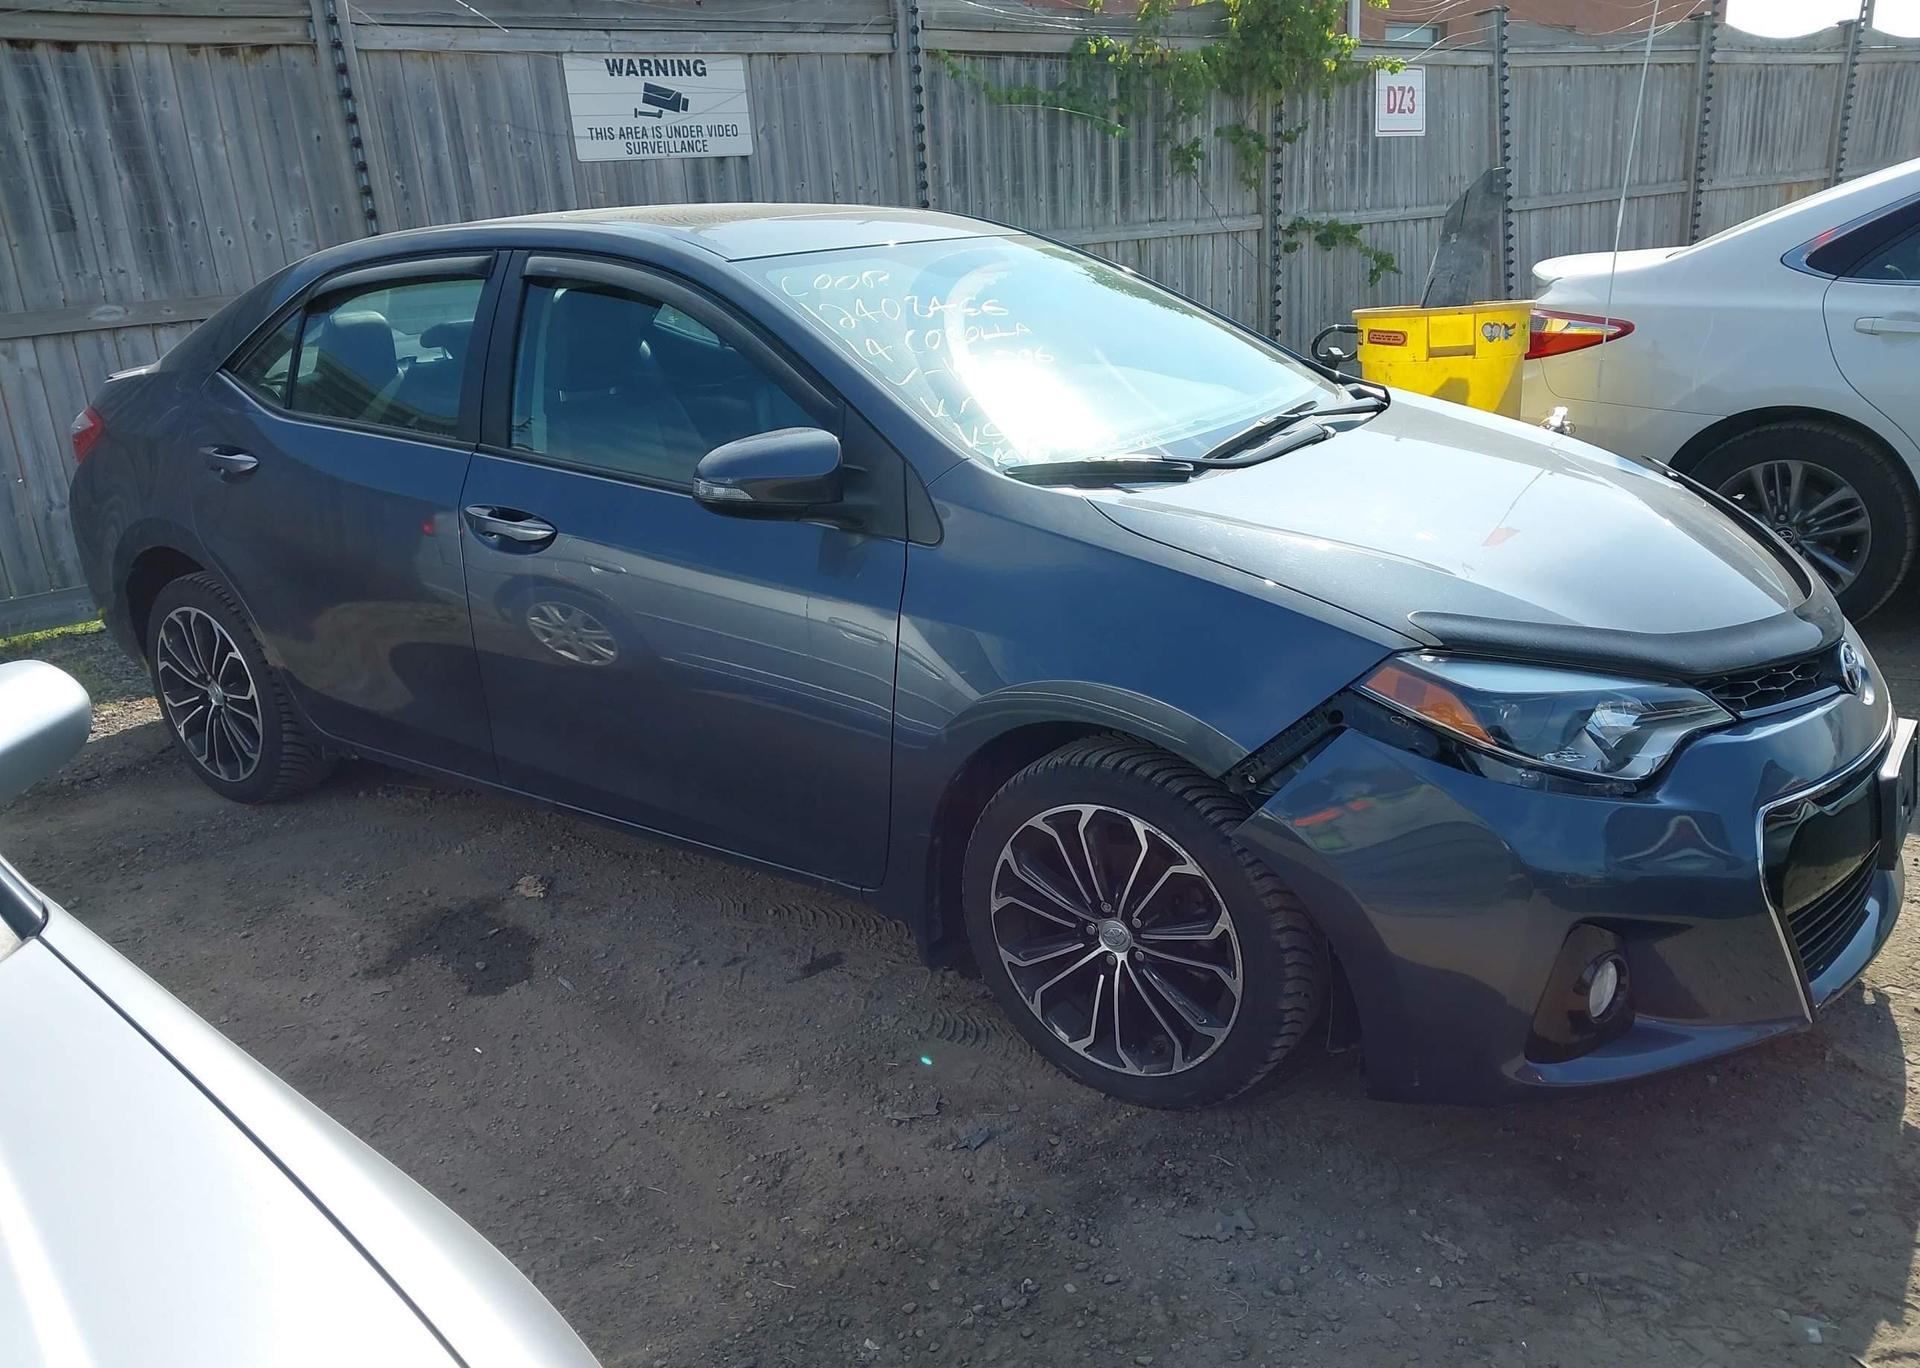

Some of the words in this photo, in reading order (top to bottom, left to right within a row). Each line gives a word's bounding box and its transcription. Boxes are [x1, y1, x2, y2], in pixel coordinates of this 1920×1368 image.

[604, 58, 707, 77] WARNING
[1386, 85, 1416, 114] DZ3
[587, 127, 615, 141] THIS
[618, 126, 648, 140] AREA
[652, 125, 662, 139] IS
[666, 125, 704, 139] UNDER
[706, 124, 739, 138] VIDEO
[626, 139, 709, 155] SURVEILLANCE
